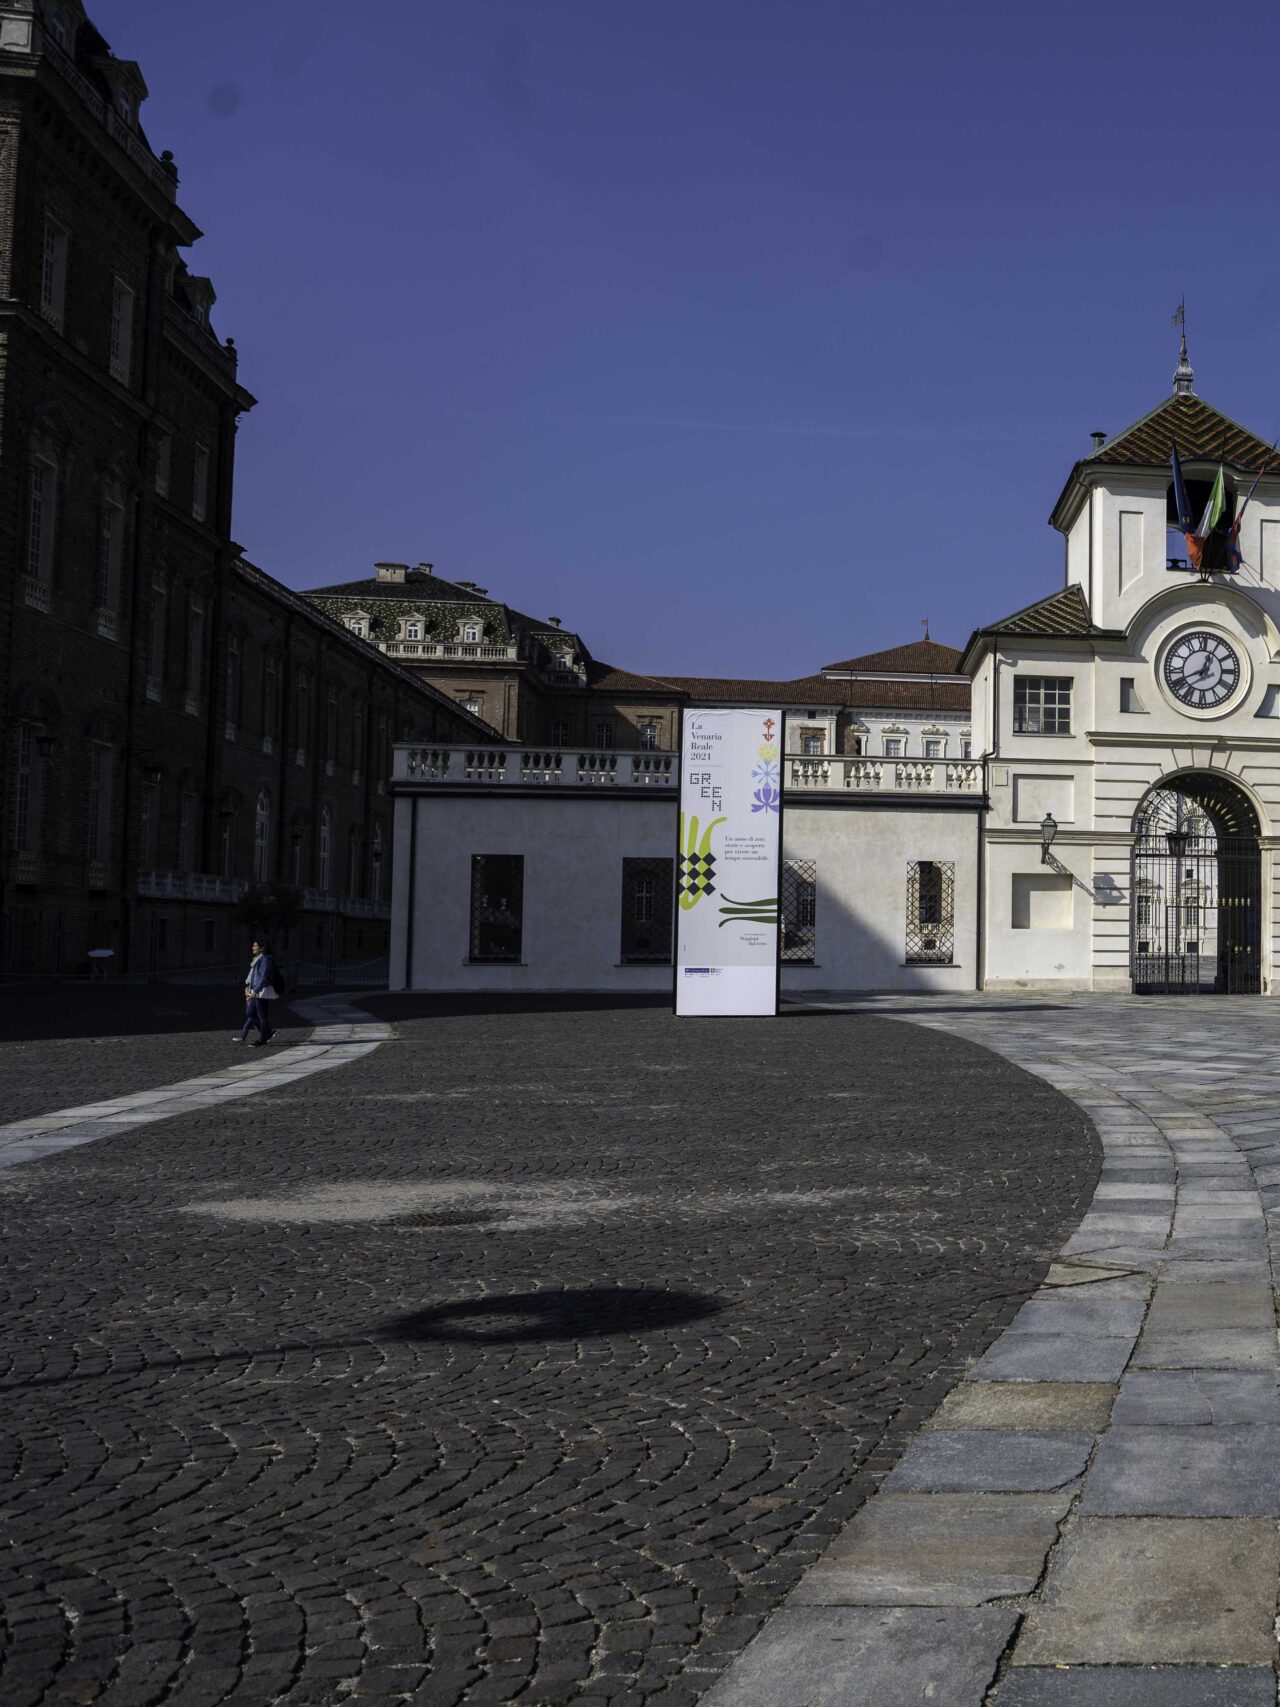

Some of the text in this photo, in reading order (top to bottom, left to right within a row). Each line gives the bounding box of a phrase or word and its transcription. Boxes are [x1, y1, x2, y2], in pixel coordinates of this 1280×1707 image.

[691, 722, 703, 730] La
[691, 732, 722, 740] Venaria
[691, 742, 713, 750] Reale
[690, 773, 711, 785] GR
[701, 786, 722, 798] EE
